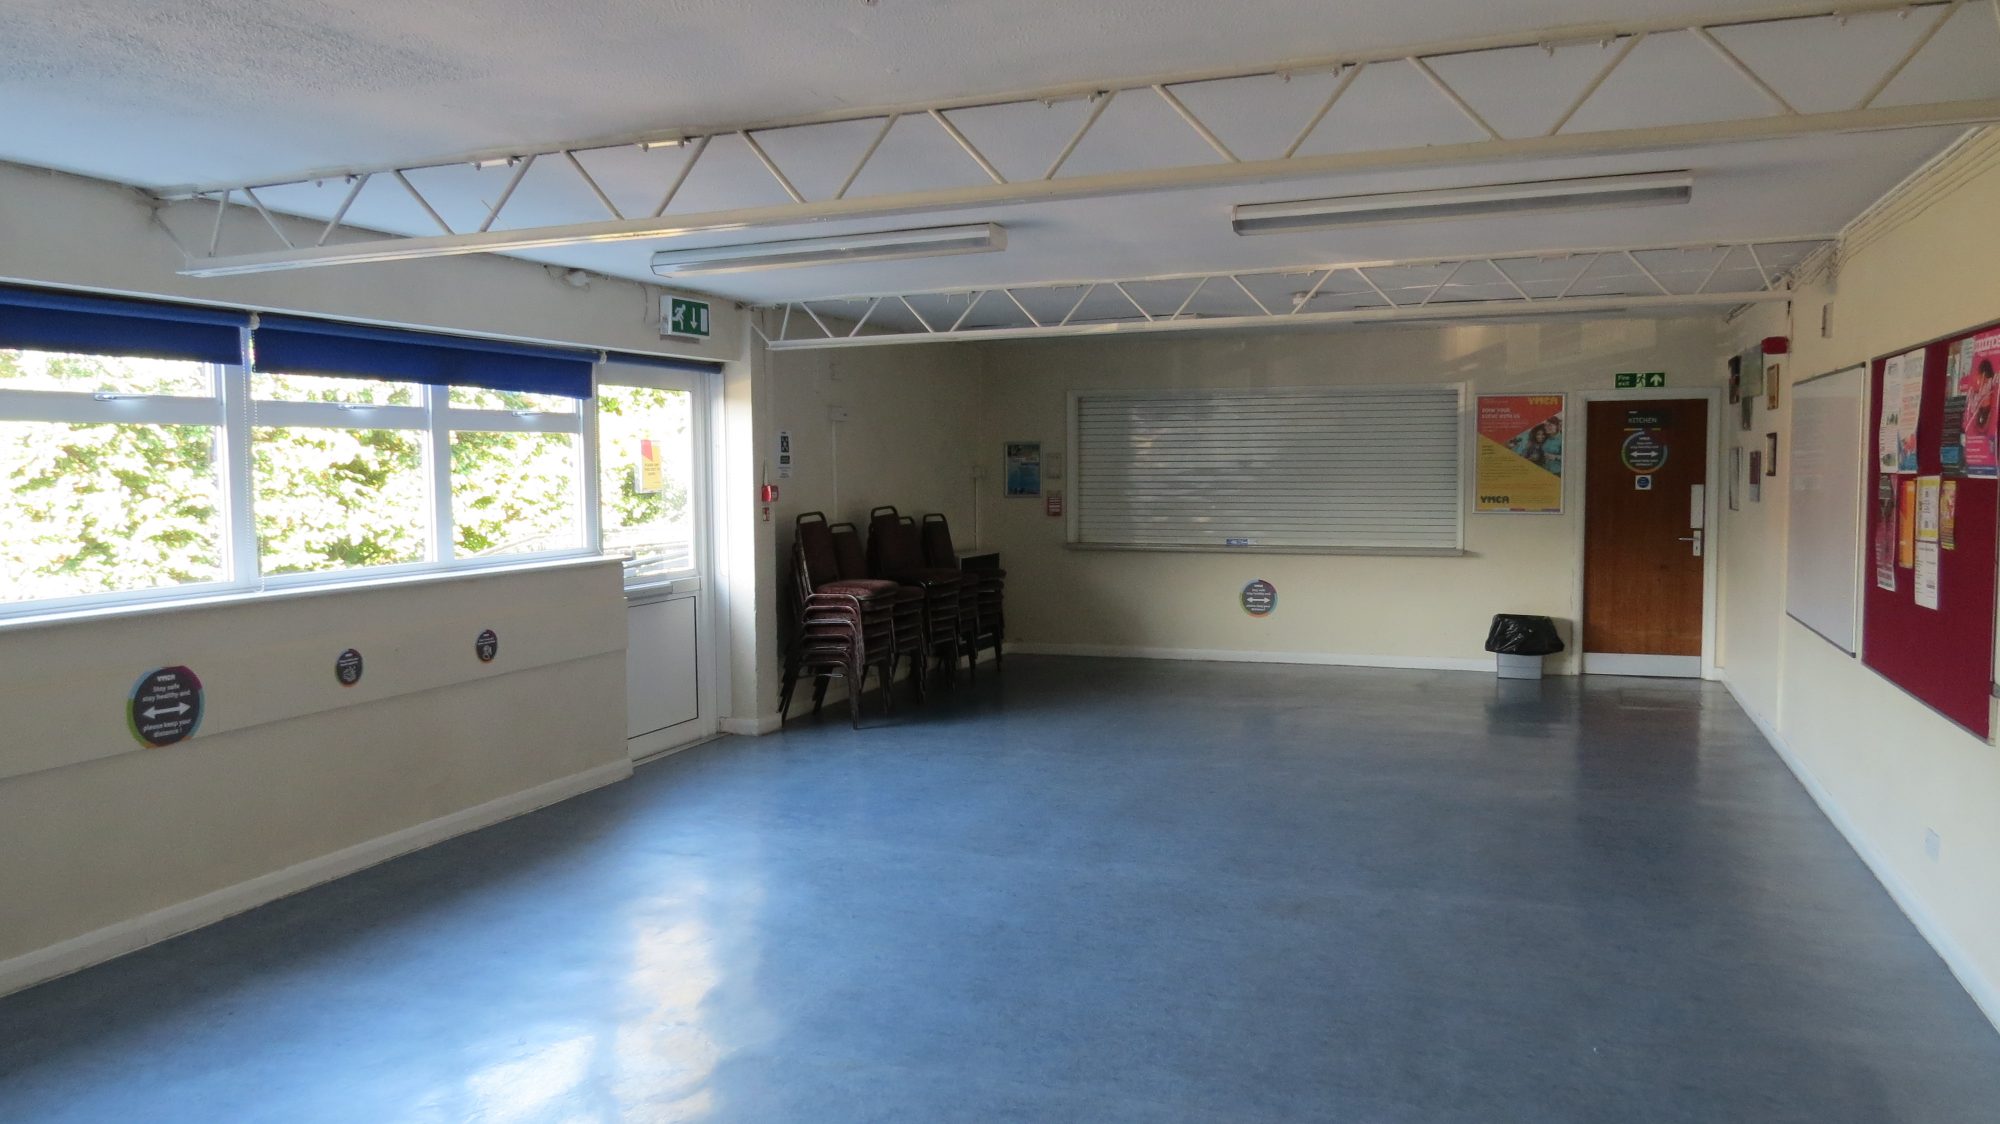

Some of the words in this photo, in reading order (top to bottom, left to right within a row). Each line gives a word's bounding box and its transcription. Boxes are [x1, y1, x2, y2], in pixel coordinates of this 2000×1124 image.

[1527, 397, 1559, 405] YMCA
[1480, 495, 1510, 504] YMCA
[156, 691, 179, 700] healthy
[143, 723, 163, 733] please
[163, 720, 179, 728] keep
